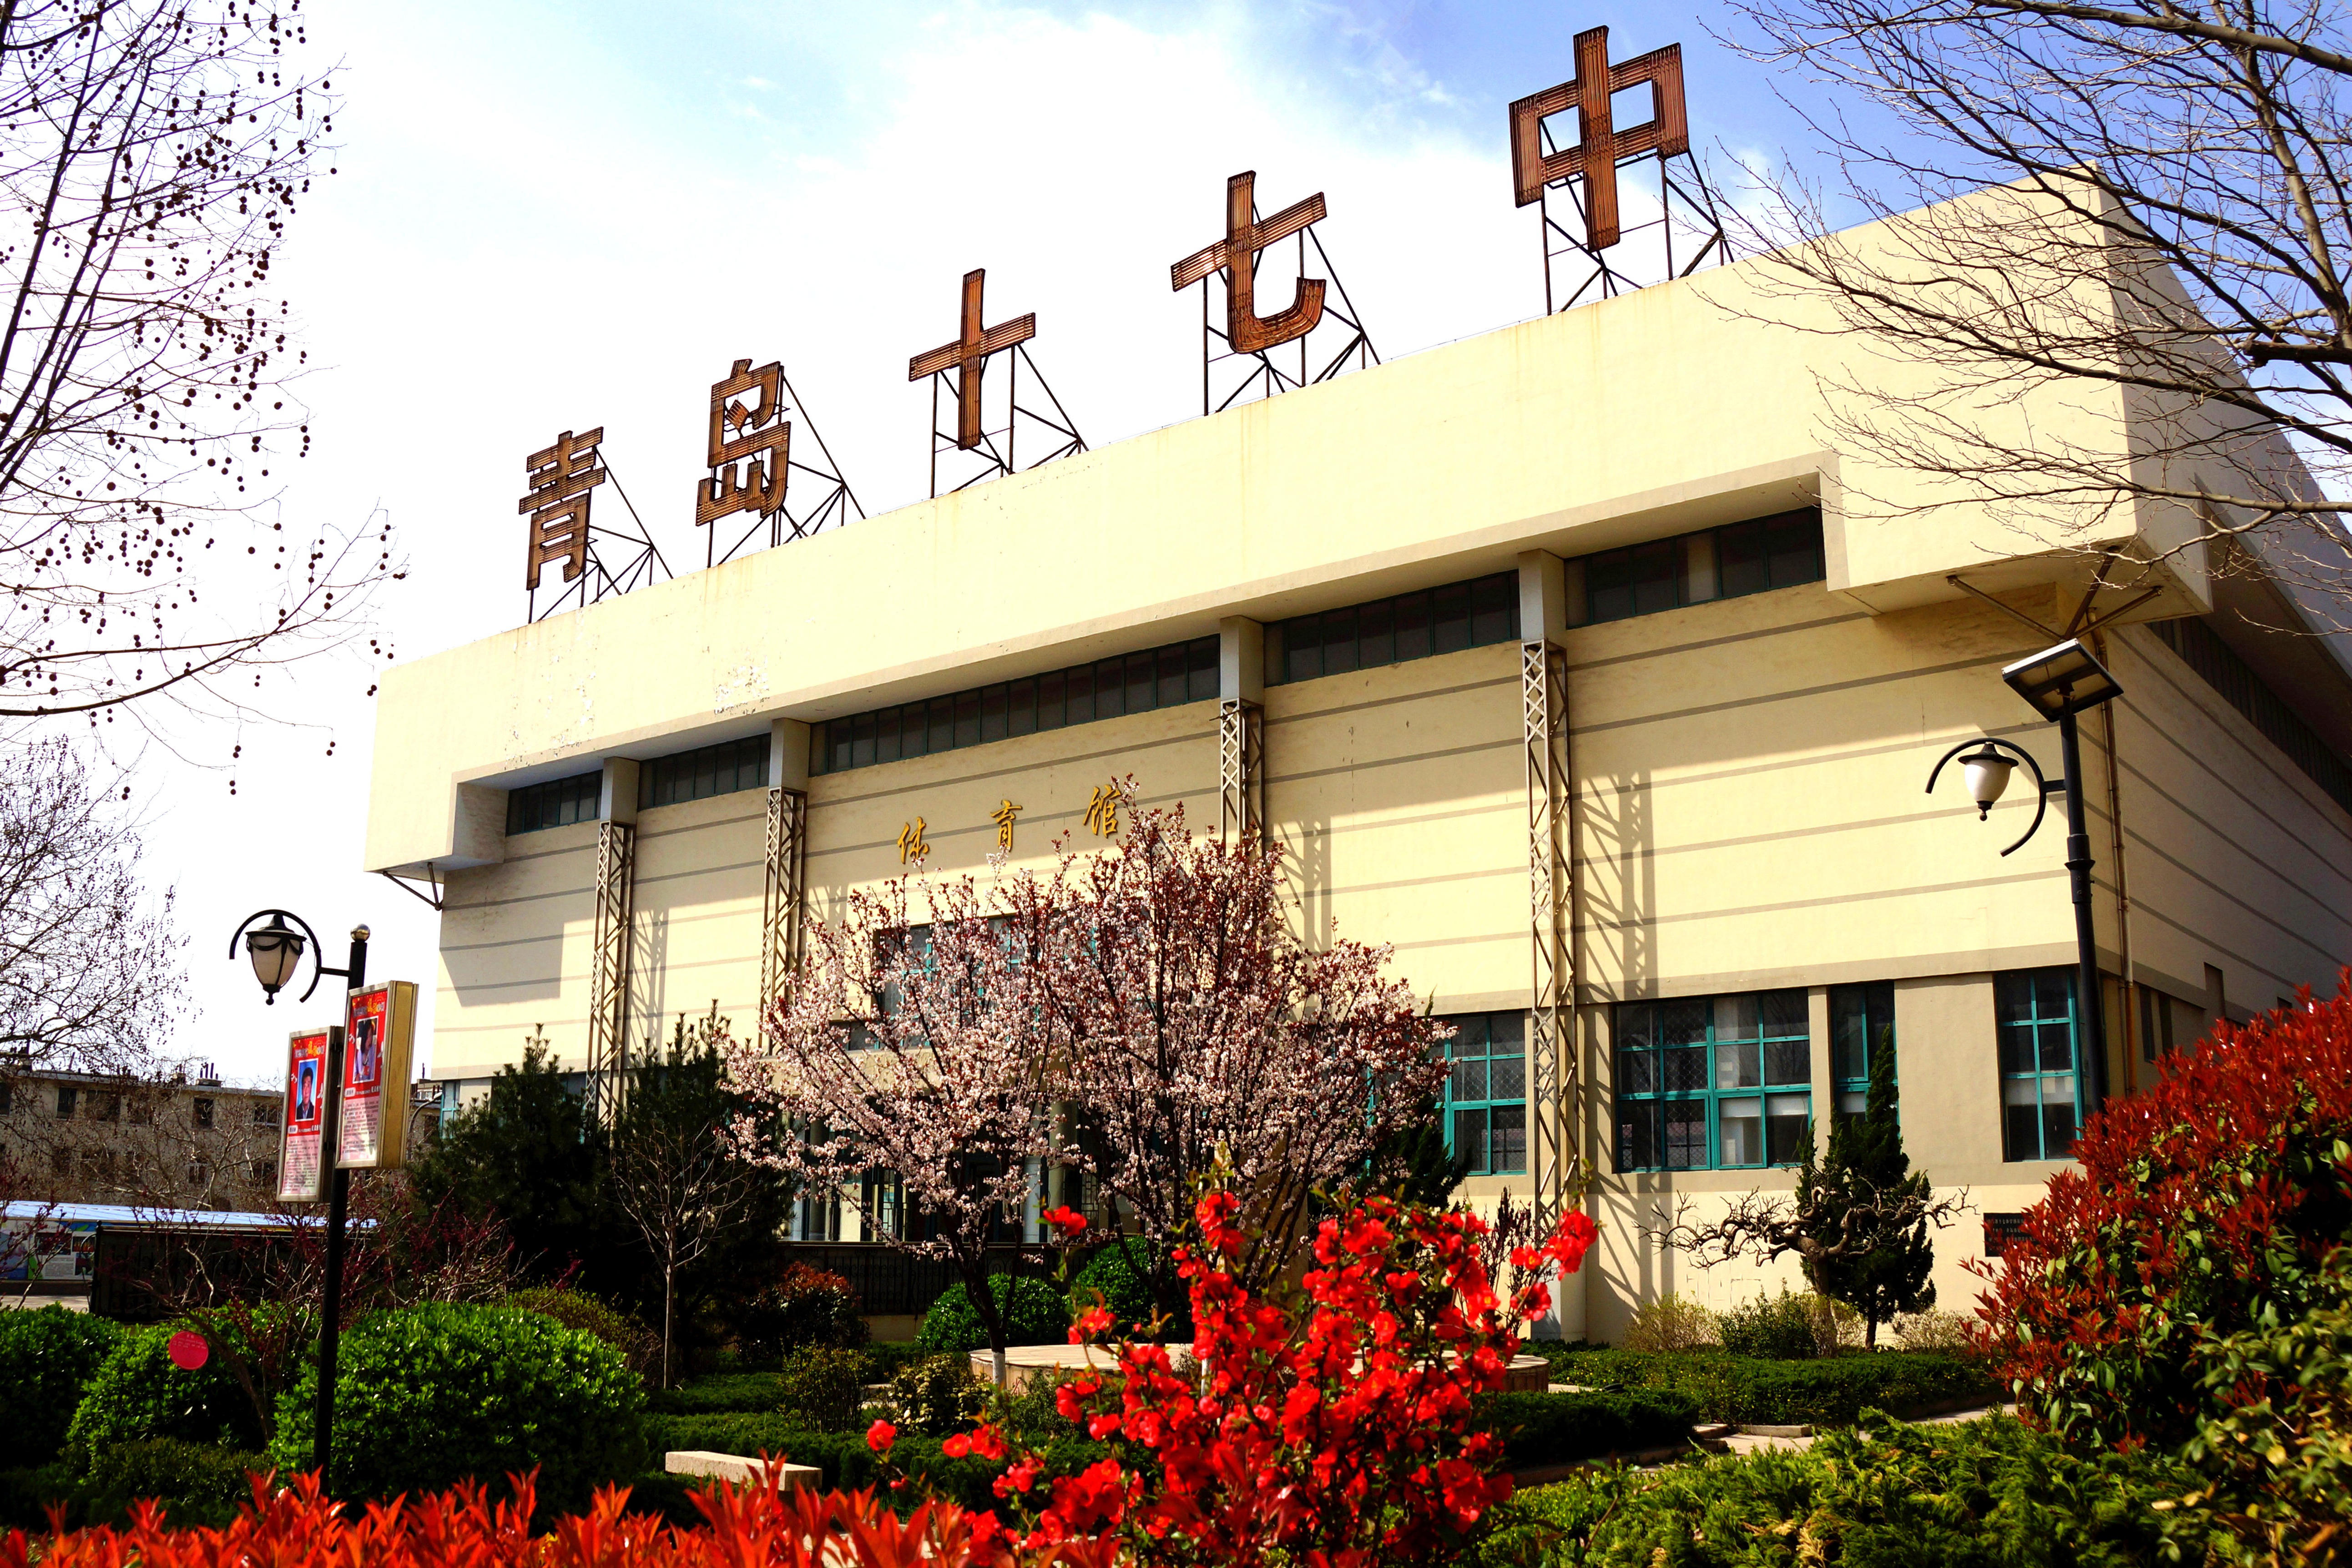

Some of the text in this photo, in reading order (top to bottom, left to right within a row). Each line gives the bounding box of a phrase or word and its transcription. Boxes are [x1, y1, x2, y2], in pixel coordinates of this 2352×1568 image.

[518, 25, 1689, 590] 青岛十七中
[897, 784, 1121, 864] 体育馆
